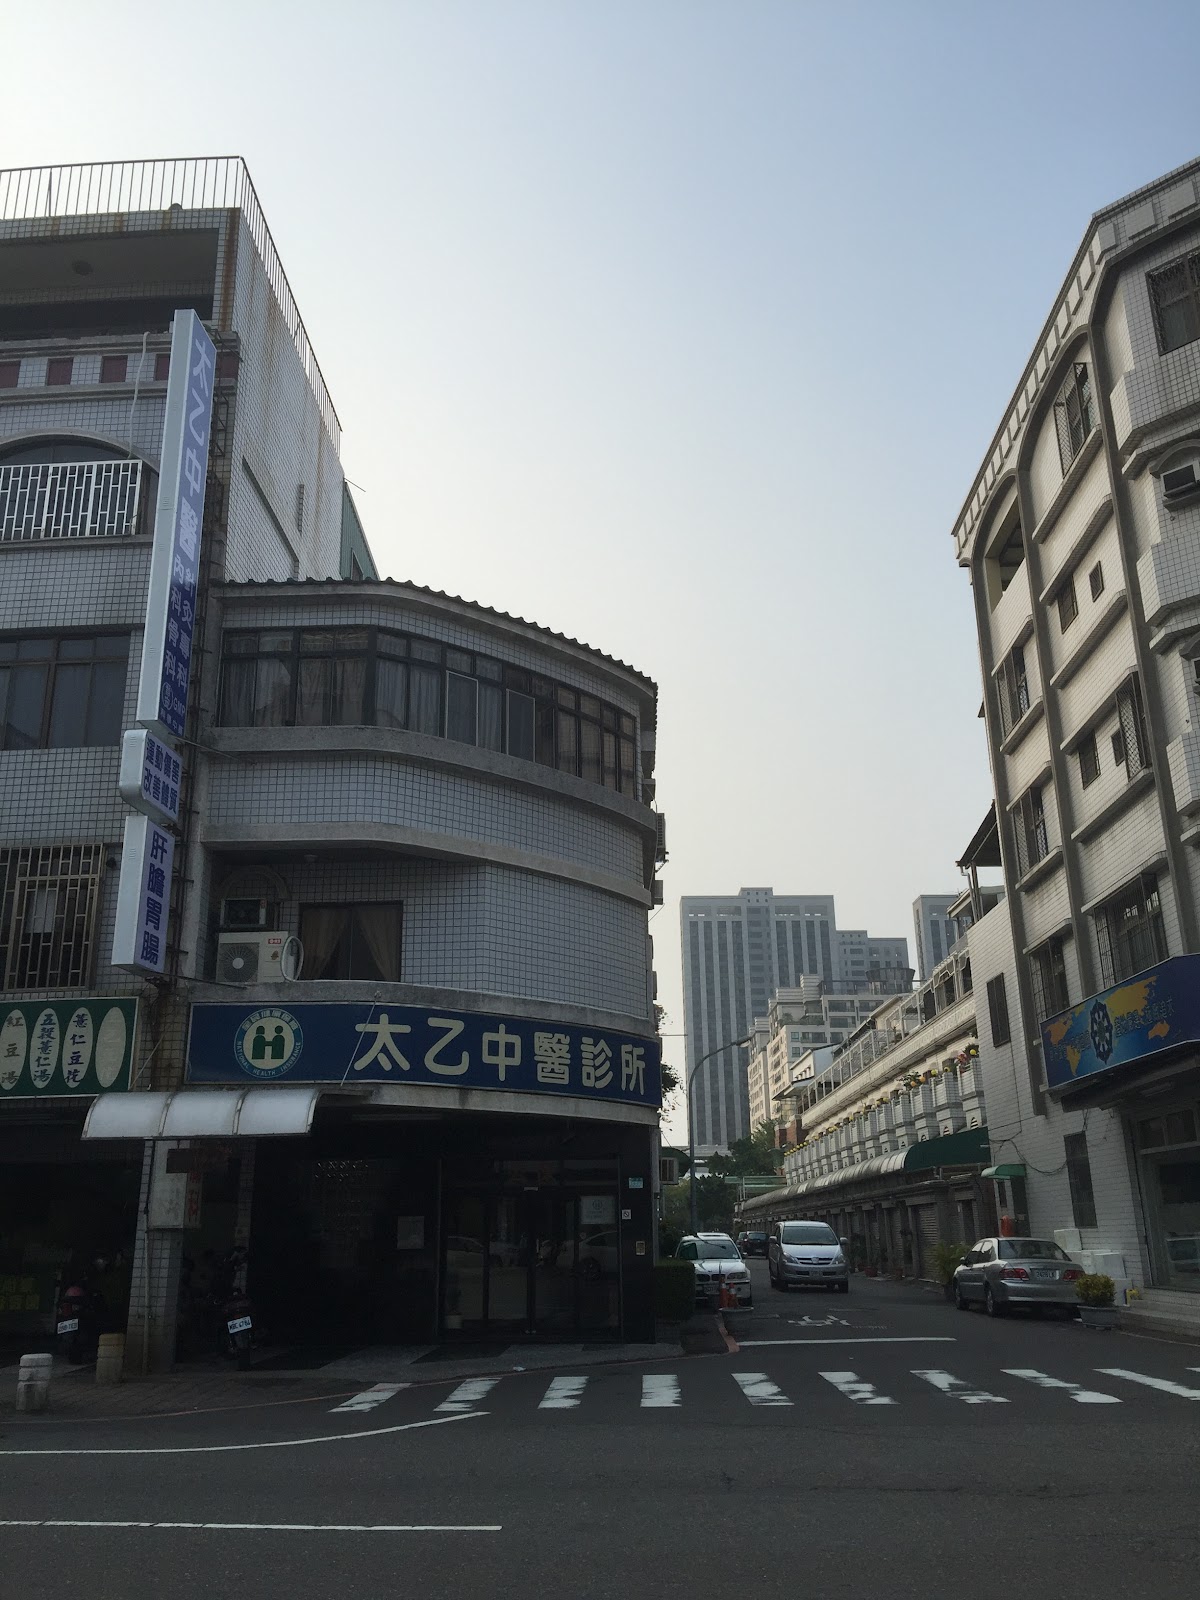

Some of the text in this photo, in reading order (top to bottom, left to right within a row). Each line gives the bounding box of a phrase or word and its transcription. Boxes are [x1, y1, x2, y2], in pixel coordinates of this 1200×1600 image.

[143, 767, 178, 815] 改善體質
[141, 829, 168, 966] 肝膽胃腸
[1, 1015, 24, 1085] 紅豆湯
[65, 1012, 89, 1084] 薏仁豆花
[252, 1068, 276, 1077] HEALTH
[353, 1012, 647, 1096] 太乙中醫診所
